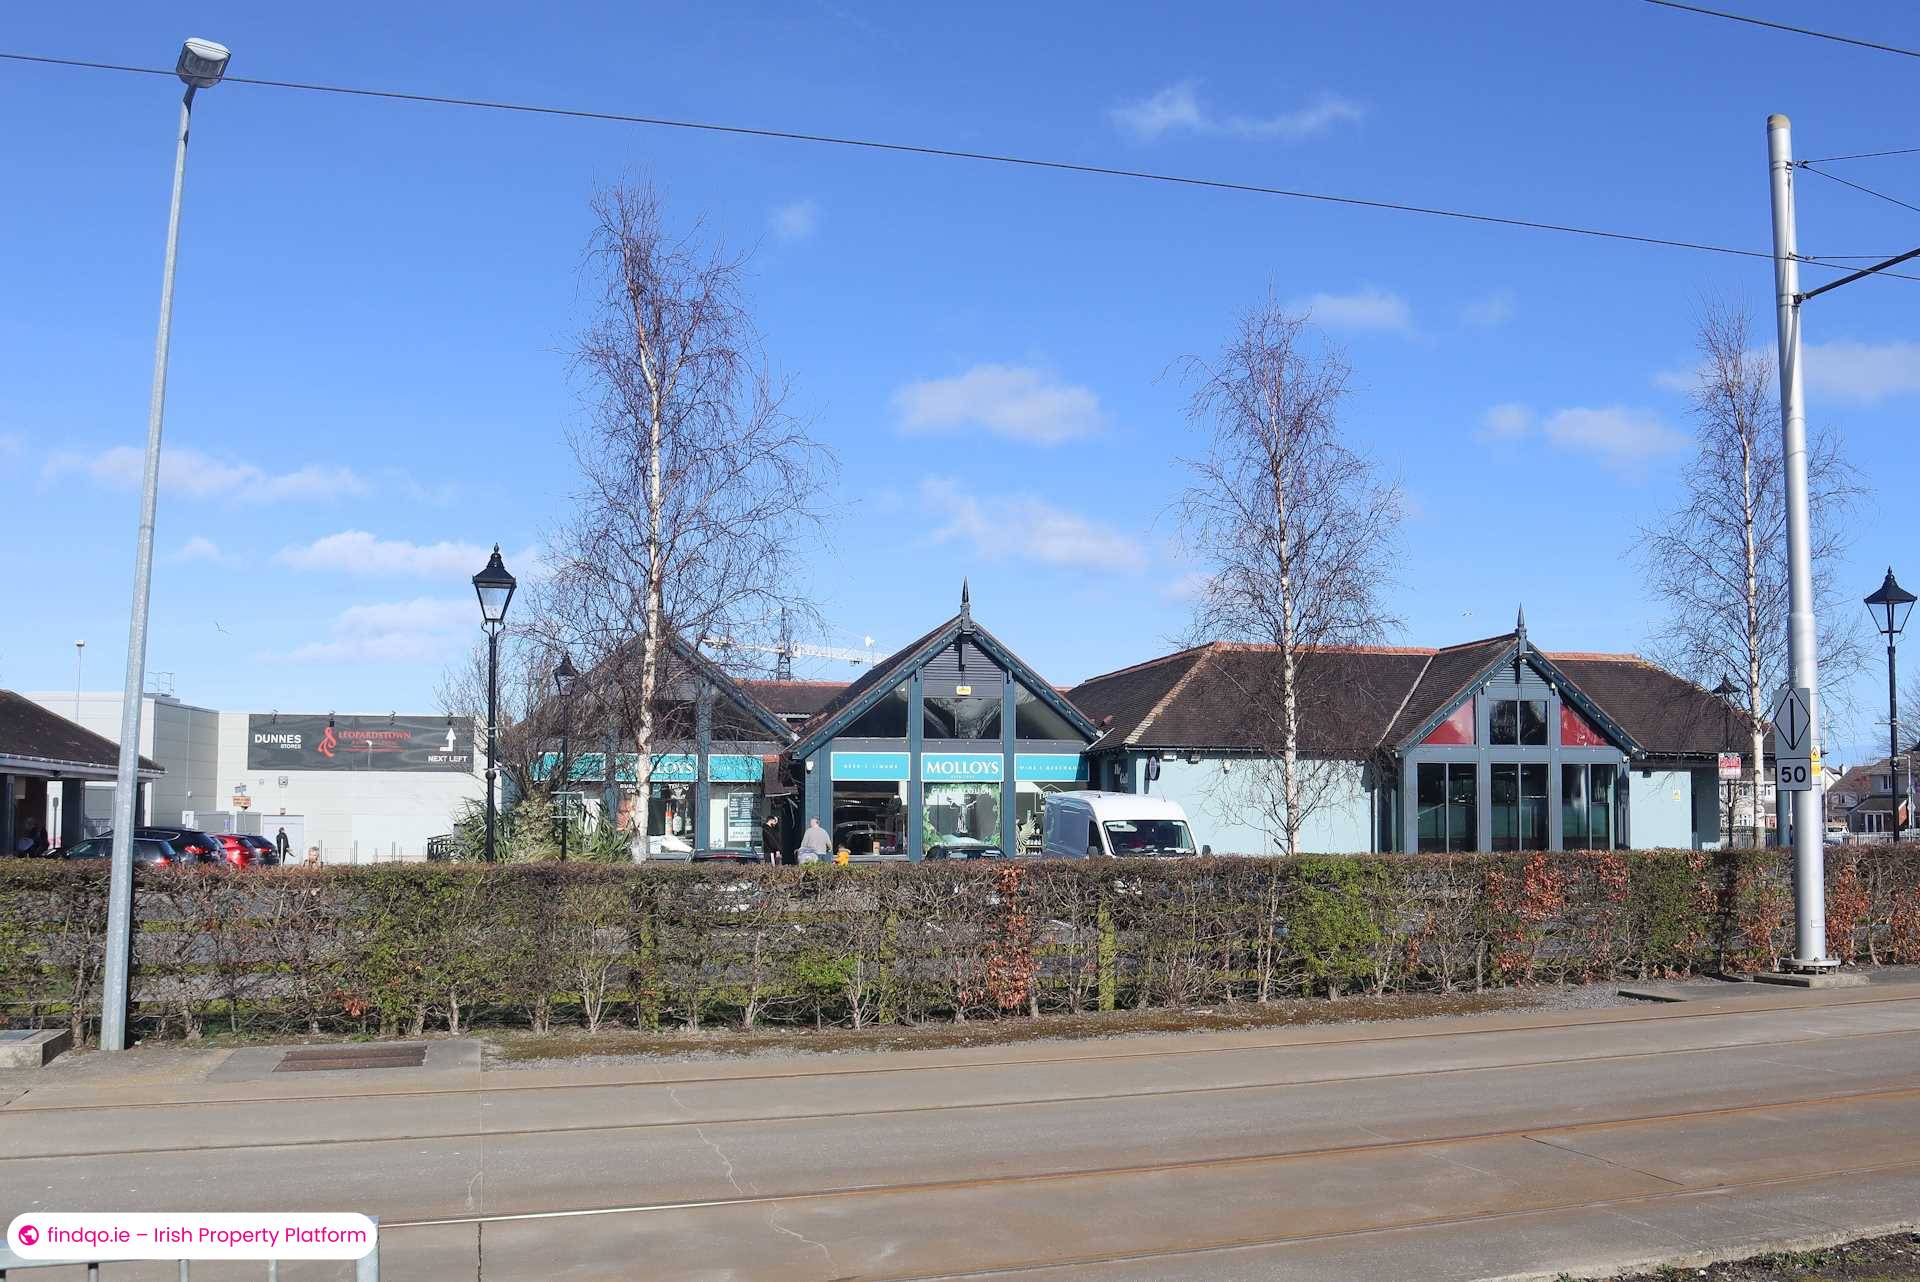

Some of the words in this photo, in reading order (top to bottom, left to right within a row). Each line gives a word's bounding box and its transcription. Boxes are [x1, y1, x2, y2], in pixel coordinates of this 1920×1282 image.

[254, 734, 302, 744] DUNNES
[338, 731, 412, 740] LEOPARDSTOWN
[927, 761, 999, 774] MOLLOYS
[1781, 766, 1807, 783] 50
